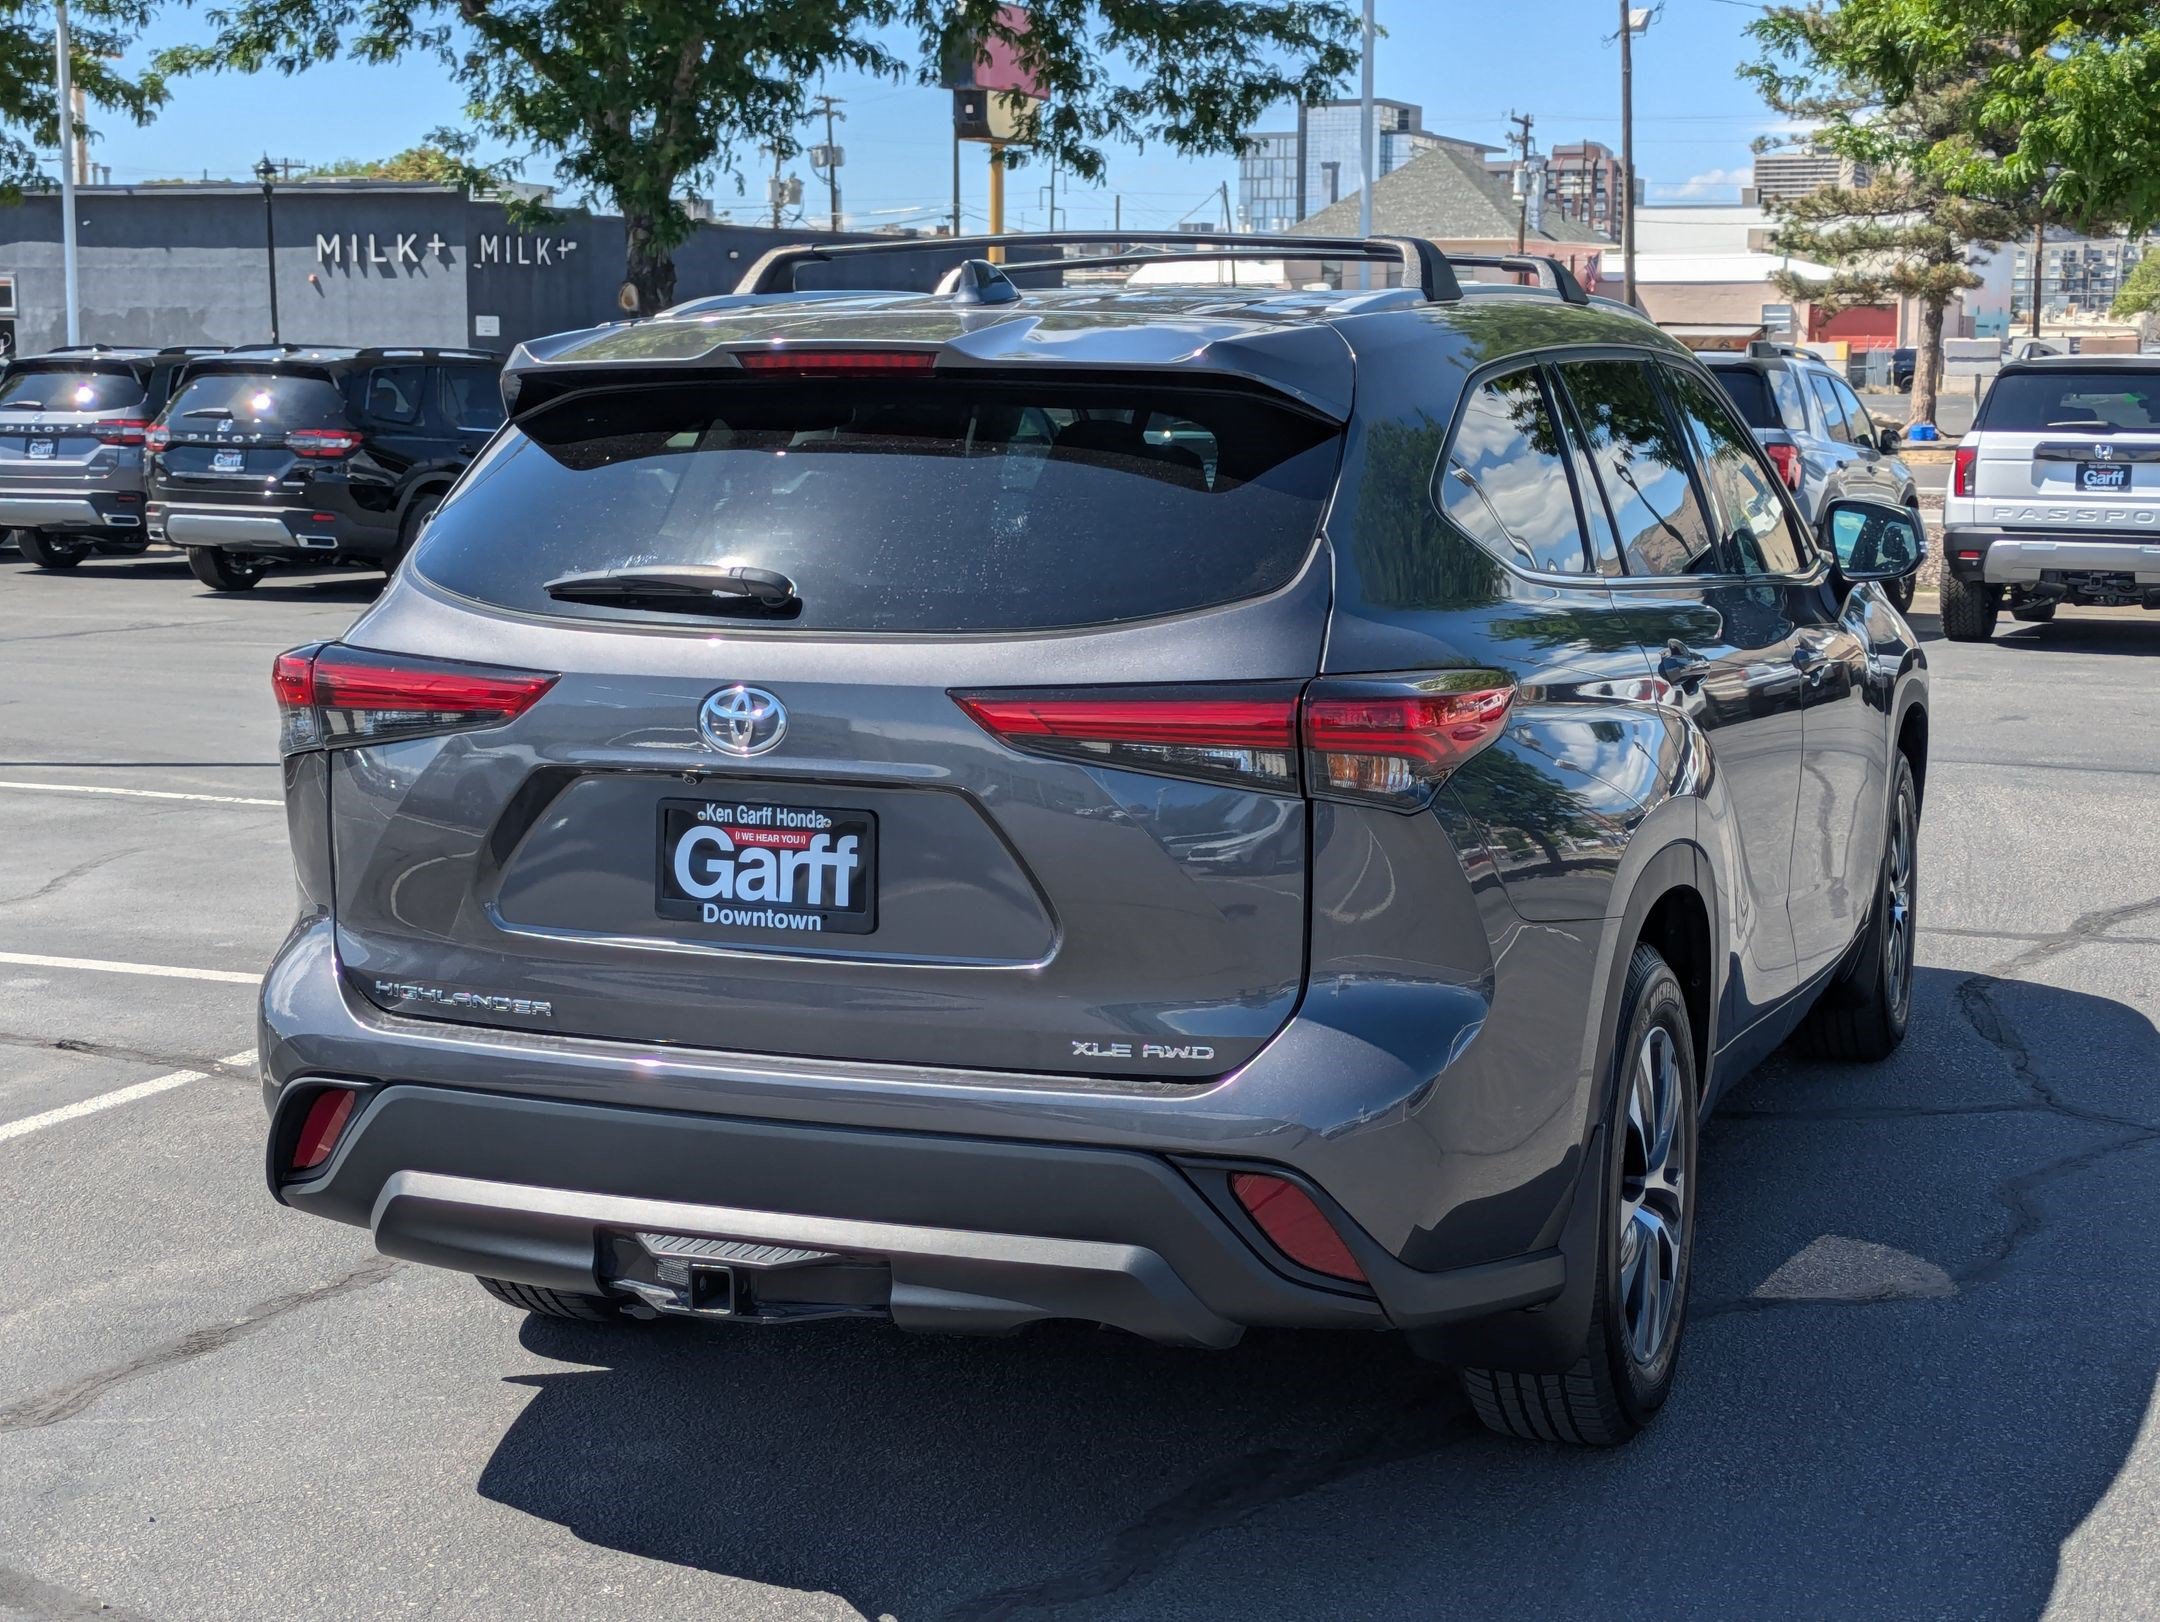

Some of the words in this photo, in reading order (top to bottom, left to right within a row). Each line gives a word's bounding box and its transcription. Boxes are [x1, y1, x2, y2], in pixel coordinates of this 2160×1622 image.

[316, 233, 446, 263] MILK+
[5, 425, 69, 433] PILOT
[187, 433, 261, 443] PILOT
[29, 442, 53, 455] Garff
[213, 452, 242, 466] Garff
[2083, 470, 2125, 485] Garff
[1993, 507, 2156, 524] PASSPO
[706, 803, 733, 823] Ken
[737, 805, 773, 826] Garff
[776, 808, 824, 829] Honda
[741, 832, 755, 841] WE
[756, 833, 780, 843] HEAR
[782, 835, 800, 844] YOU
[674, 825, 858, 907] Garff
[703, 903, 821, 931] Downtown
[375, 980, 552, 1017] HIGHLANDER
[1071, 1040, 1132, 1058] XLE
[1142, 1043, 1215, 1060] AWD
